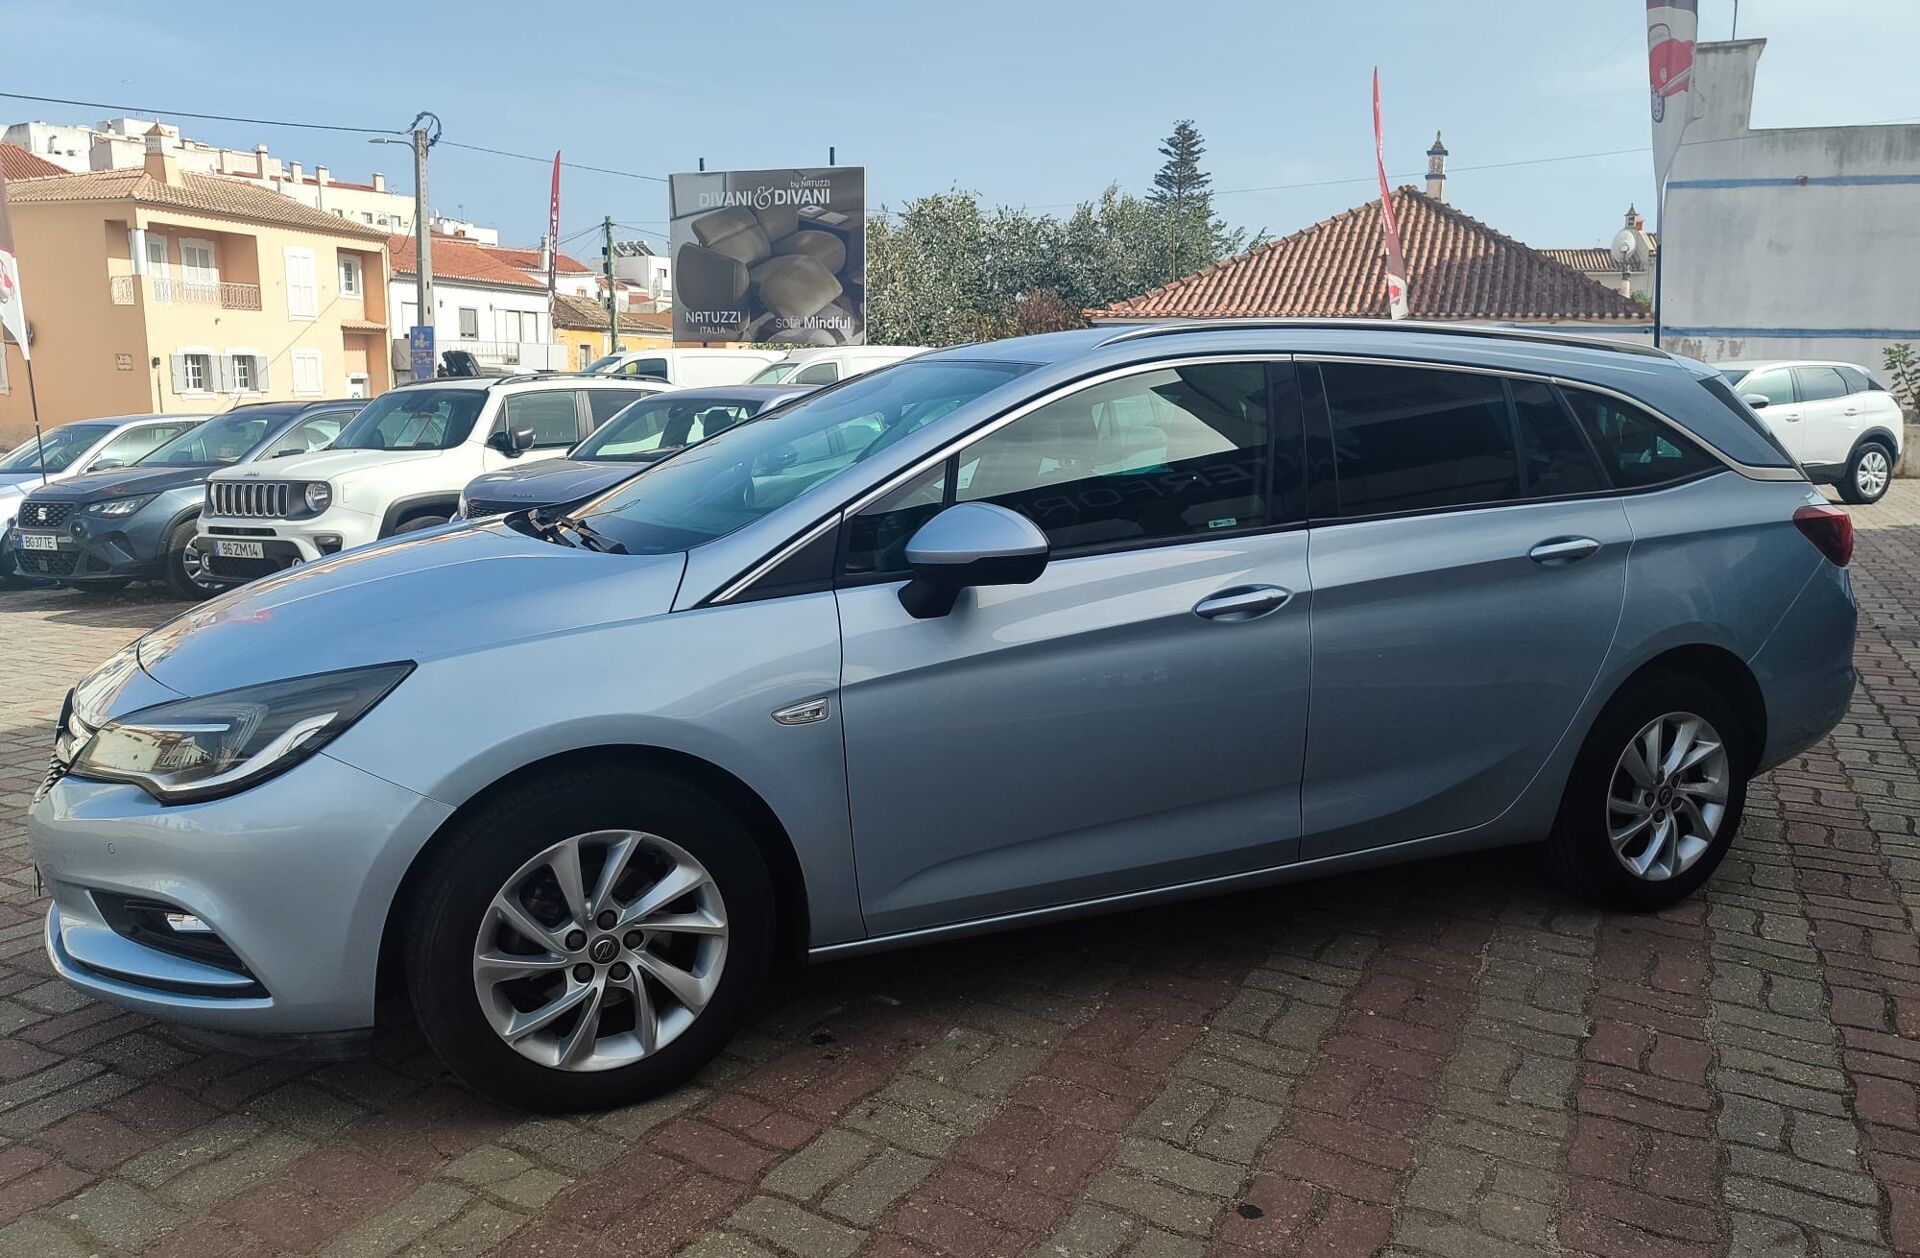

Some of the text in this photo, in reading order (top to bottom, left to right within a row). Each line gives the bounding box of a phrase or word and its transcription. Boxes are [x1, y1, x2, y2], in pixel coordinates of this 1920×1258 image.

[790, 180, 799, 188] by
[685, 311, 741, 324] NATUZZI
[804, 316, 851, 330] Mindful
[700, 326, 726, 335] ITALIA
